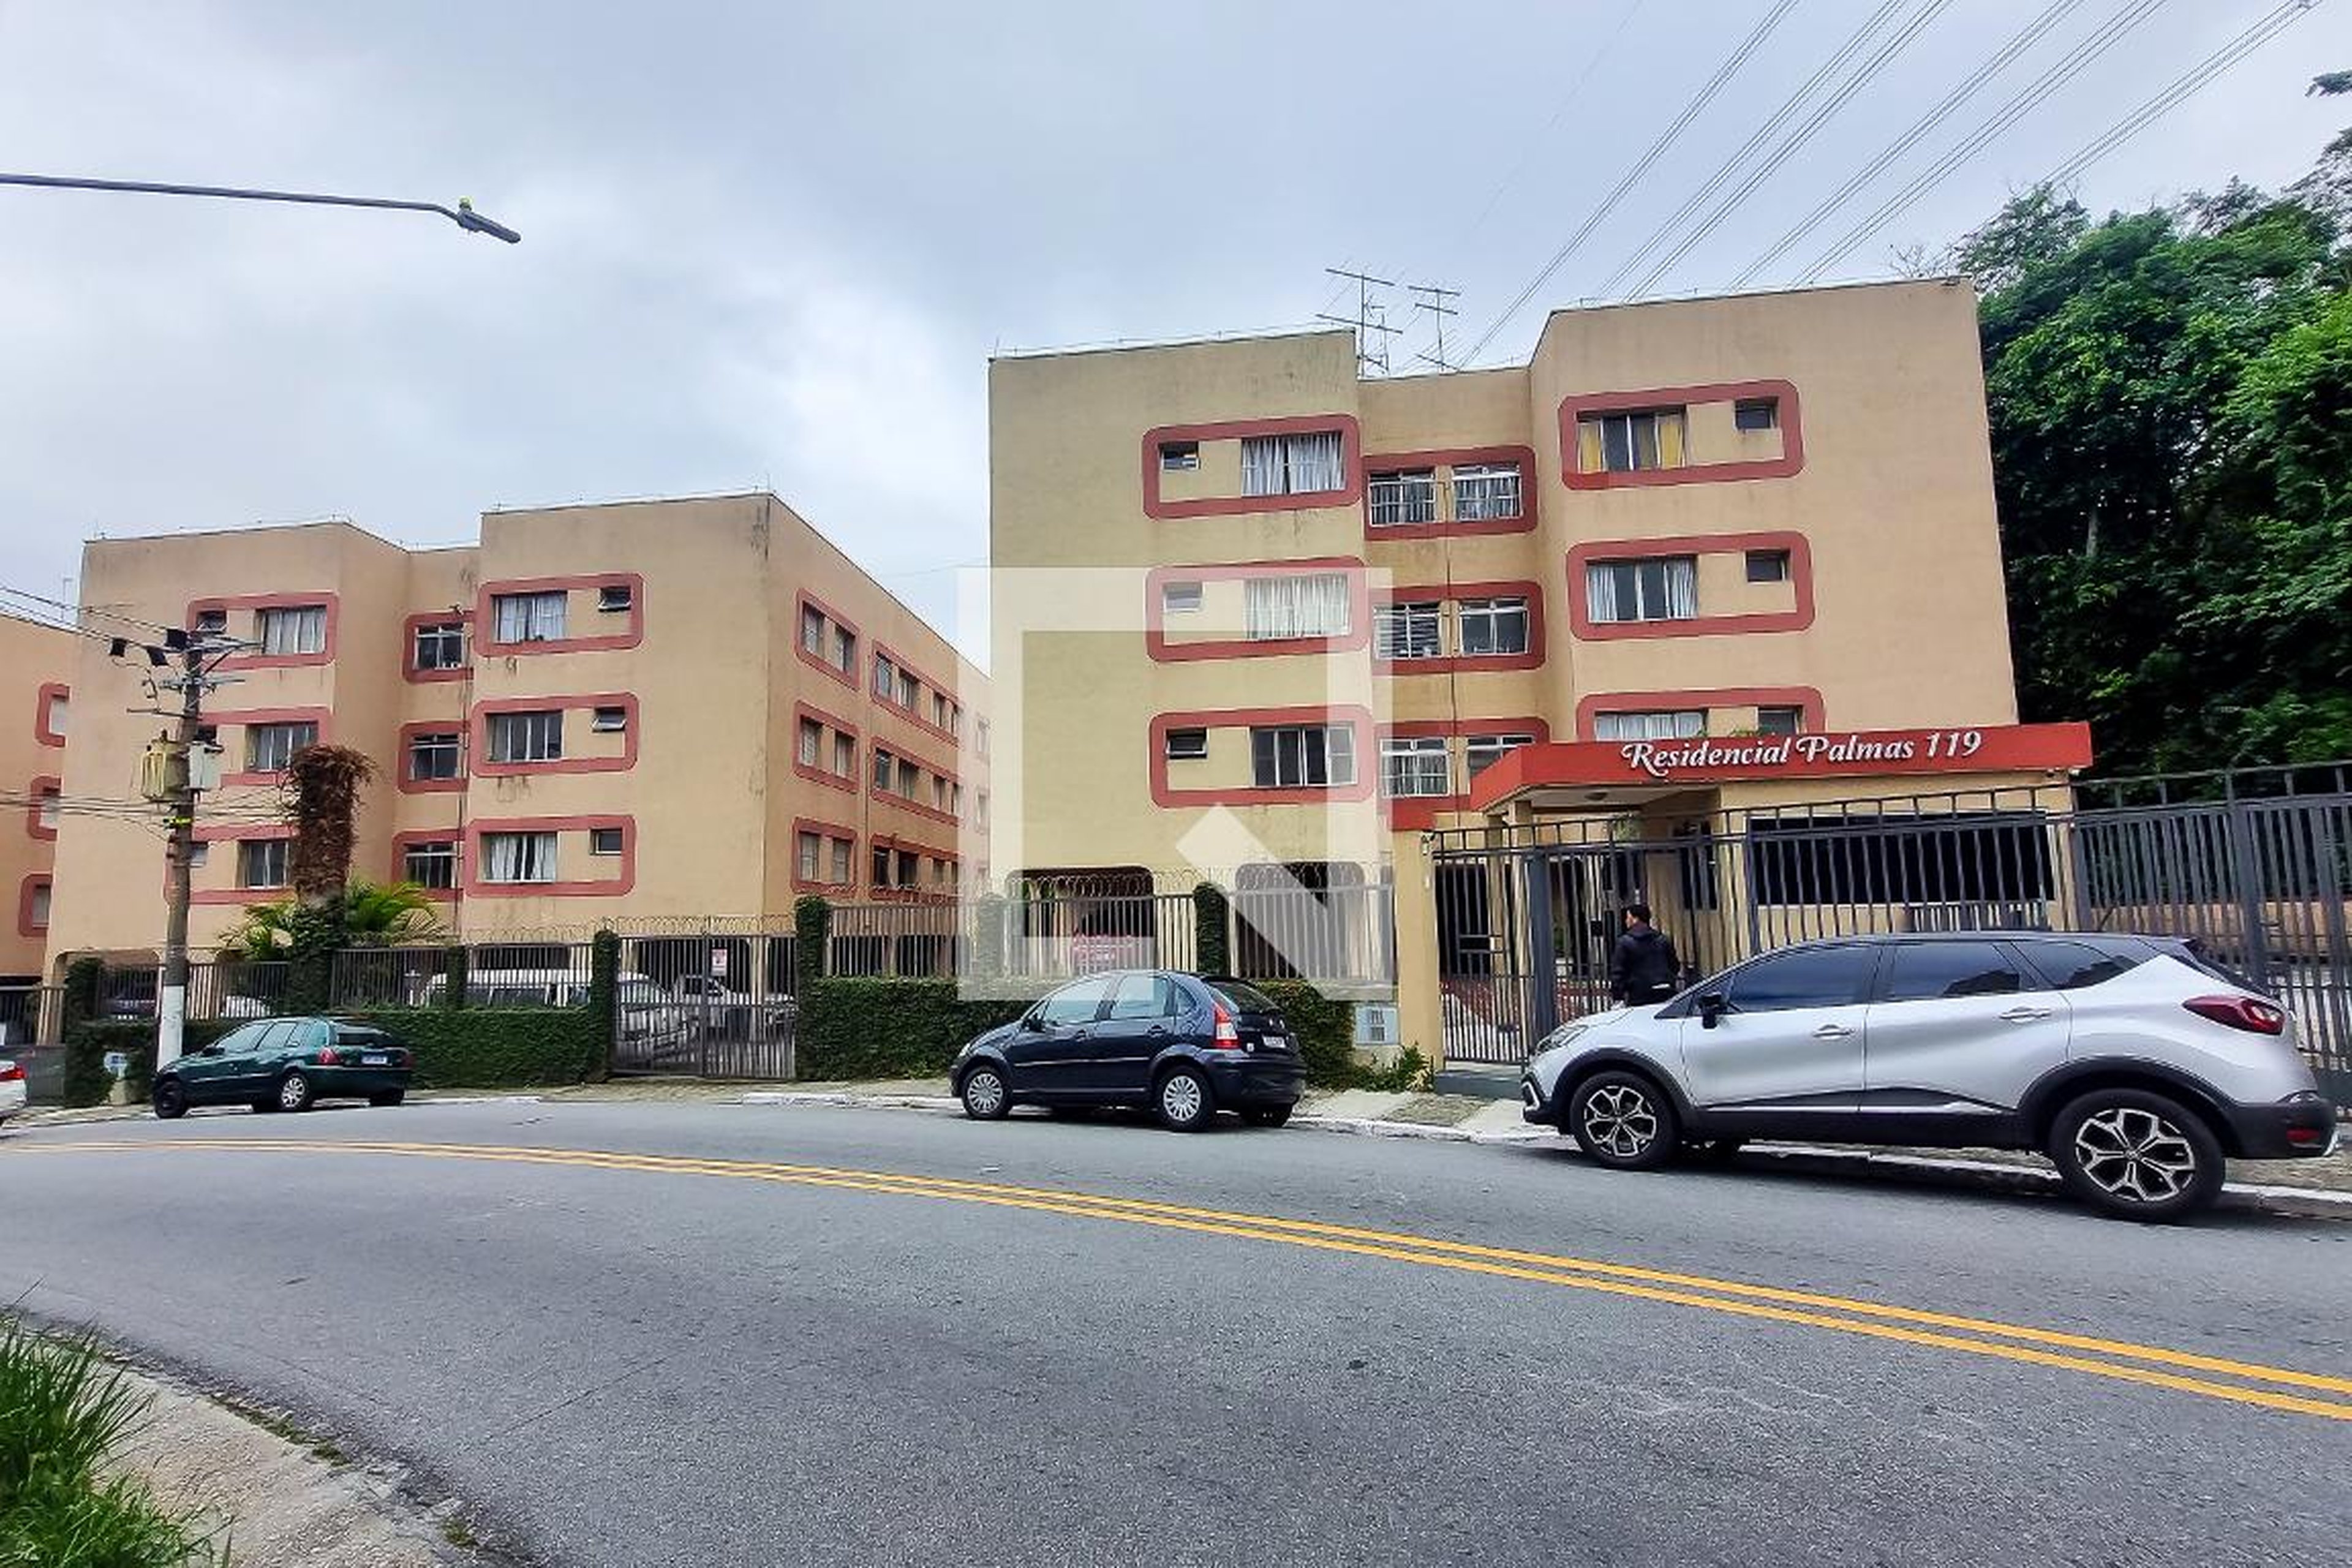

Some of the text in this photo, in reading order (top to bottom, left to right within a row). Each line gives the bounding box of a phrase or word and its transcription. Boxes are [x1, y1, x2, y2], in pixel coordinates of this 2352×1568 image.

[1621, 731, 1981, 777] Residencial Palmas 119
